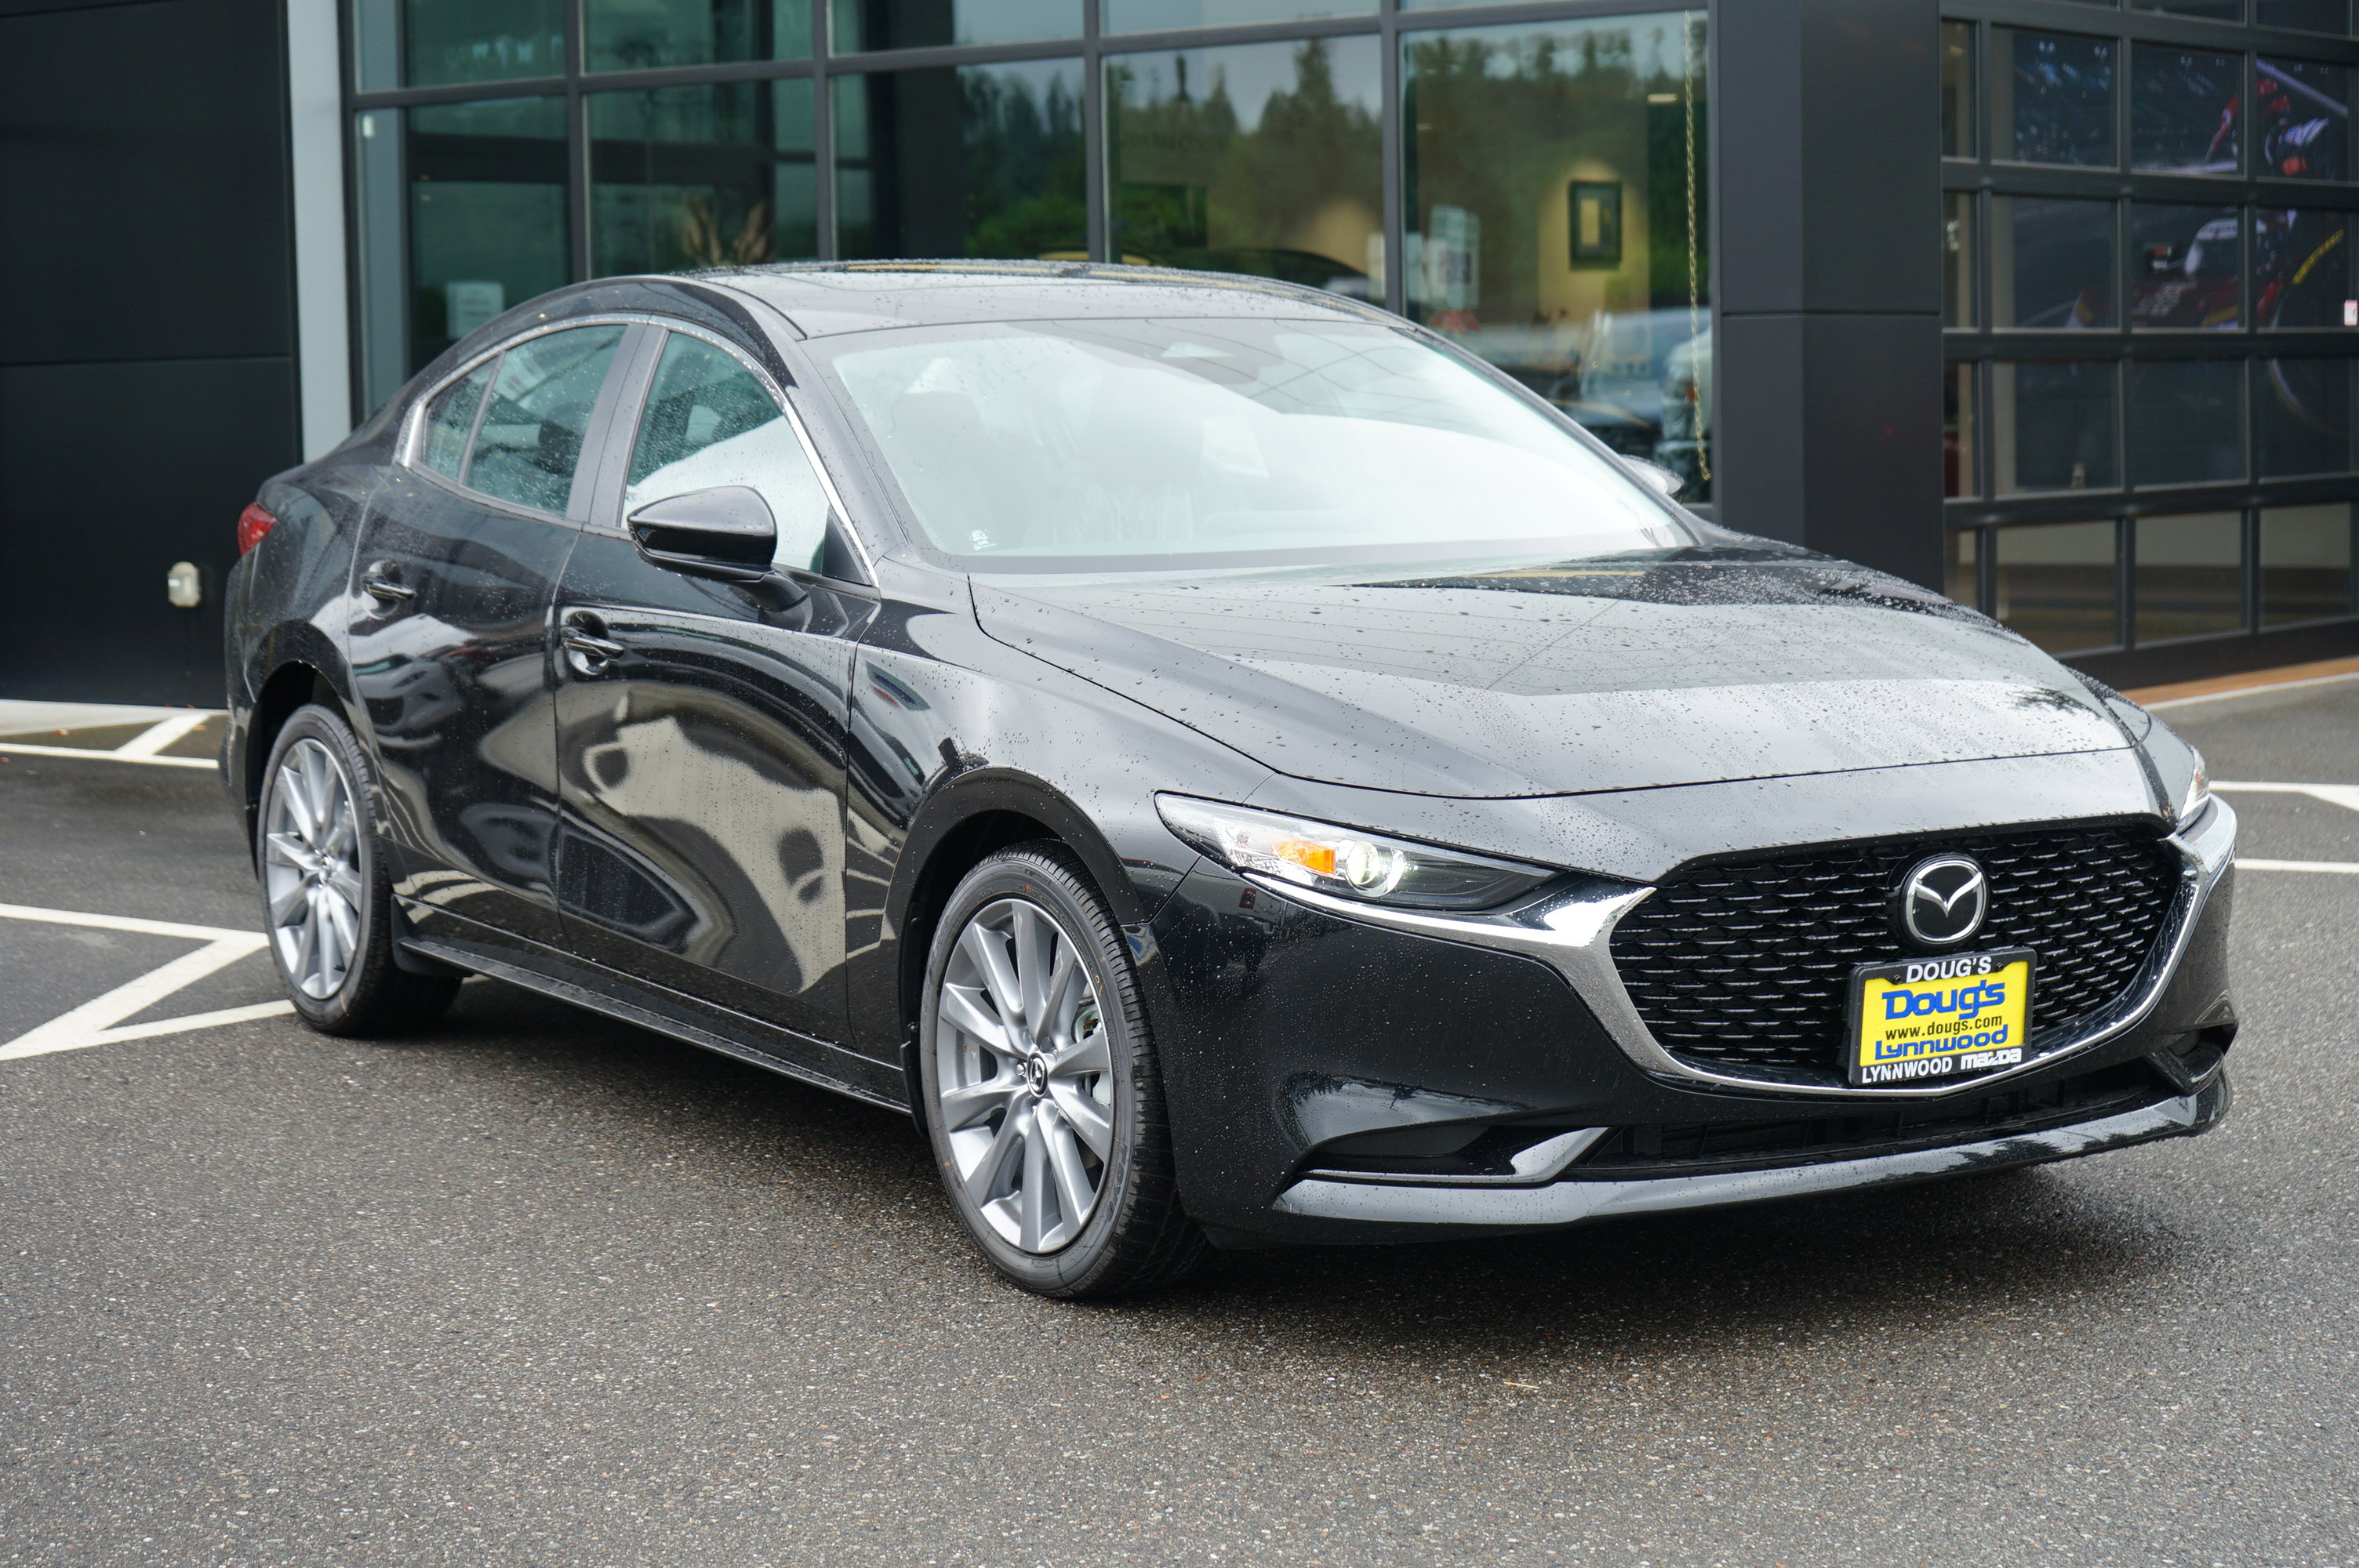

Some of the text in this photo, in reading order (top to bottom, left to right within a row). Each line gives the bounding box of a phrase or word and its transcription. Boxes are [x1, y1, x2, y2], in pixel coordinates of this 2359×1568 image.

[1906, 956, 1992, 983] DOUG'S
[1881, 979, 2005, 1020] Doug's
[1885, 1015, 2002, 1040] www.dougs.com
[1875, 1024, 2008, 1060] Lynnwood
[1862, 1057, 1953, 1083] LYNNWOOD
